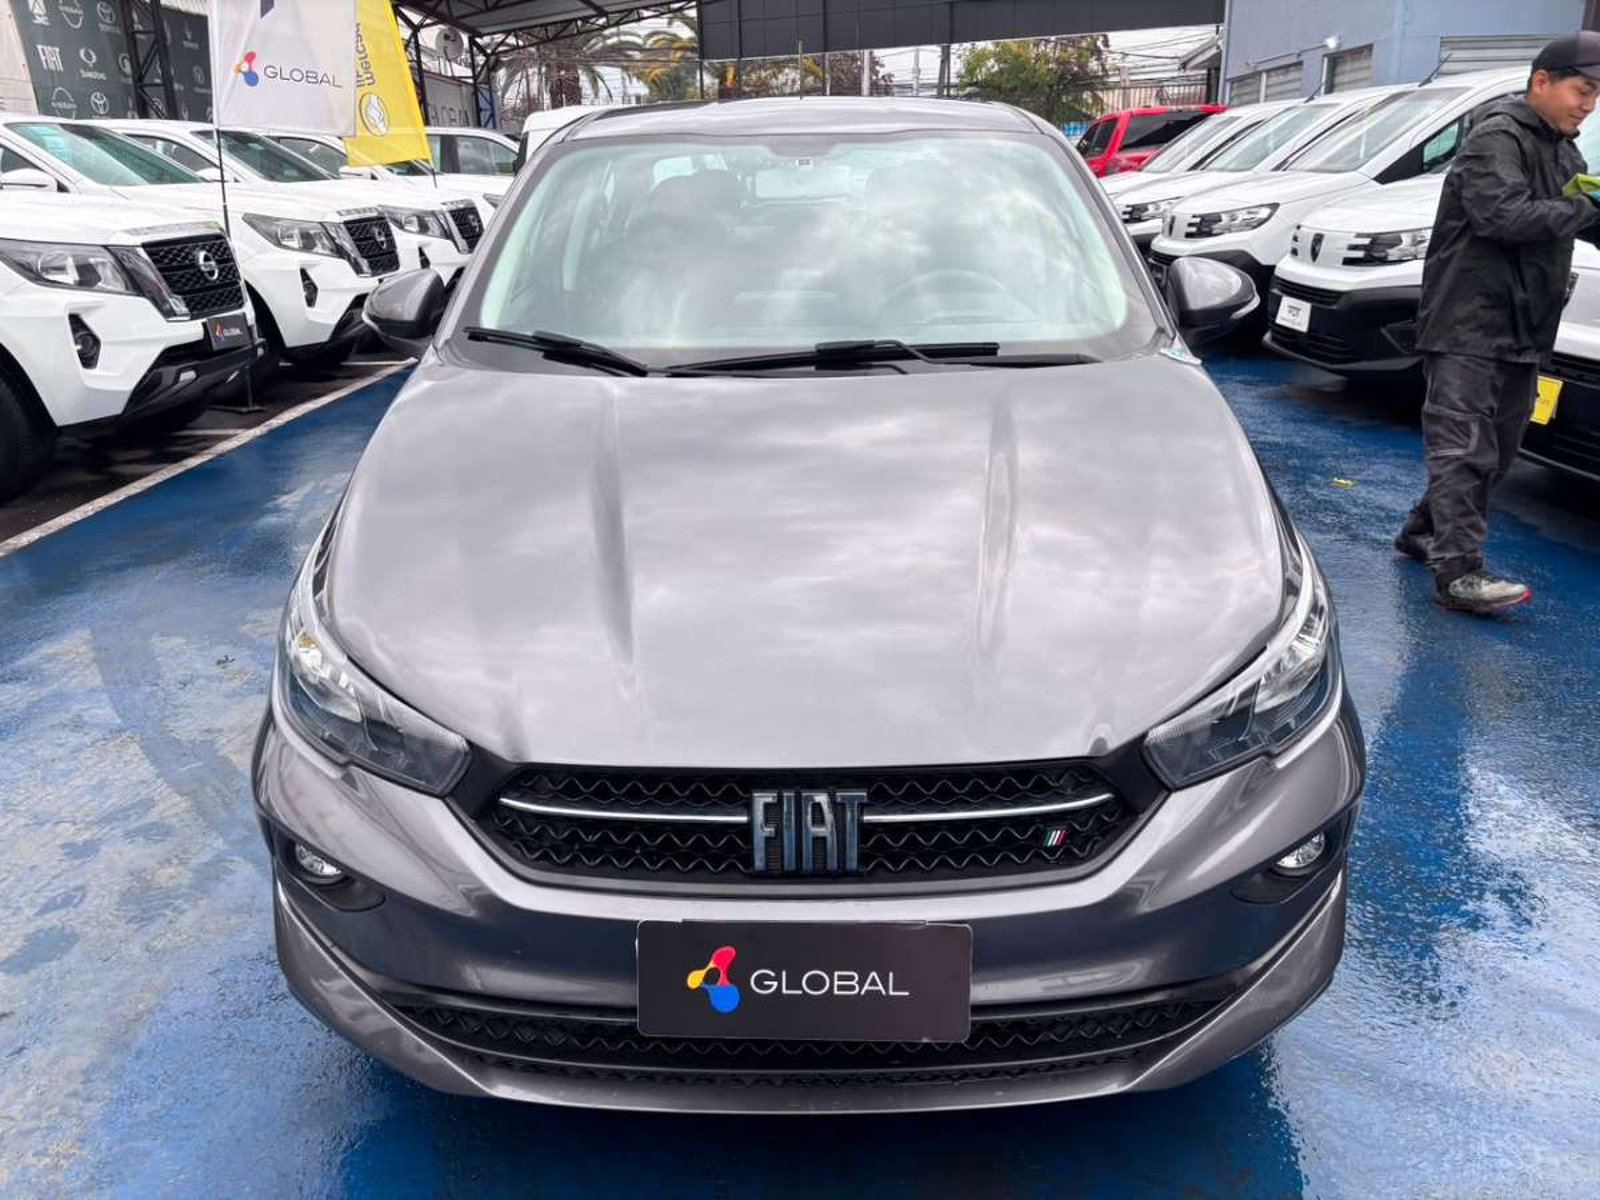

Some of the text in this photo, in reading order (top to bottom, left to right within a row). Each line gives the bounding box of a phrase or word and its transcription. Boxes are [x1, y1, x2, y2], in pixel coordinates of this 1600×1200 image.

[36, 43, 64, 72] FIAT
[263, 64, 343, 89] GLOBAL
[752, 791, 868, 873] FIAT
[749, 969, 911, 998] GLOBAL
